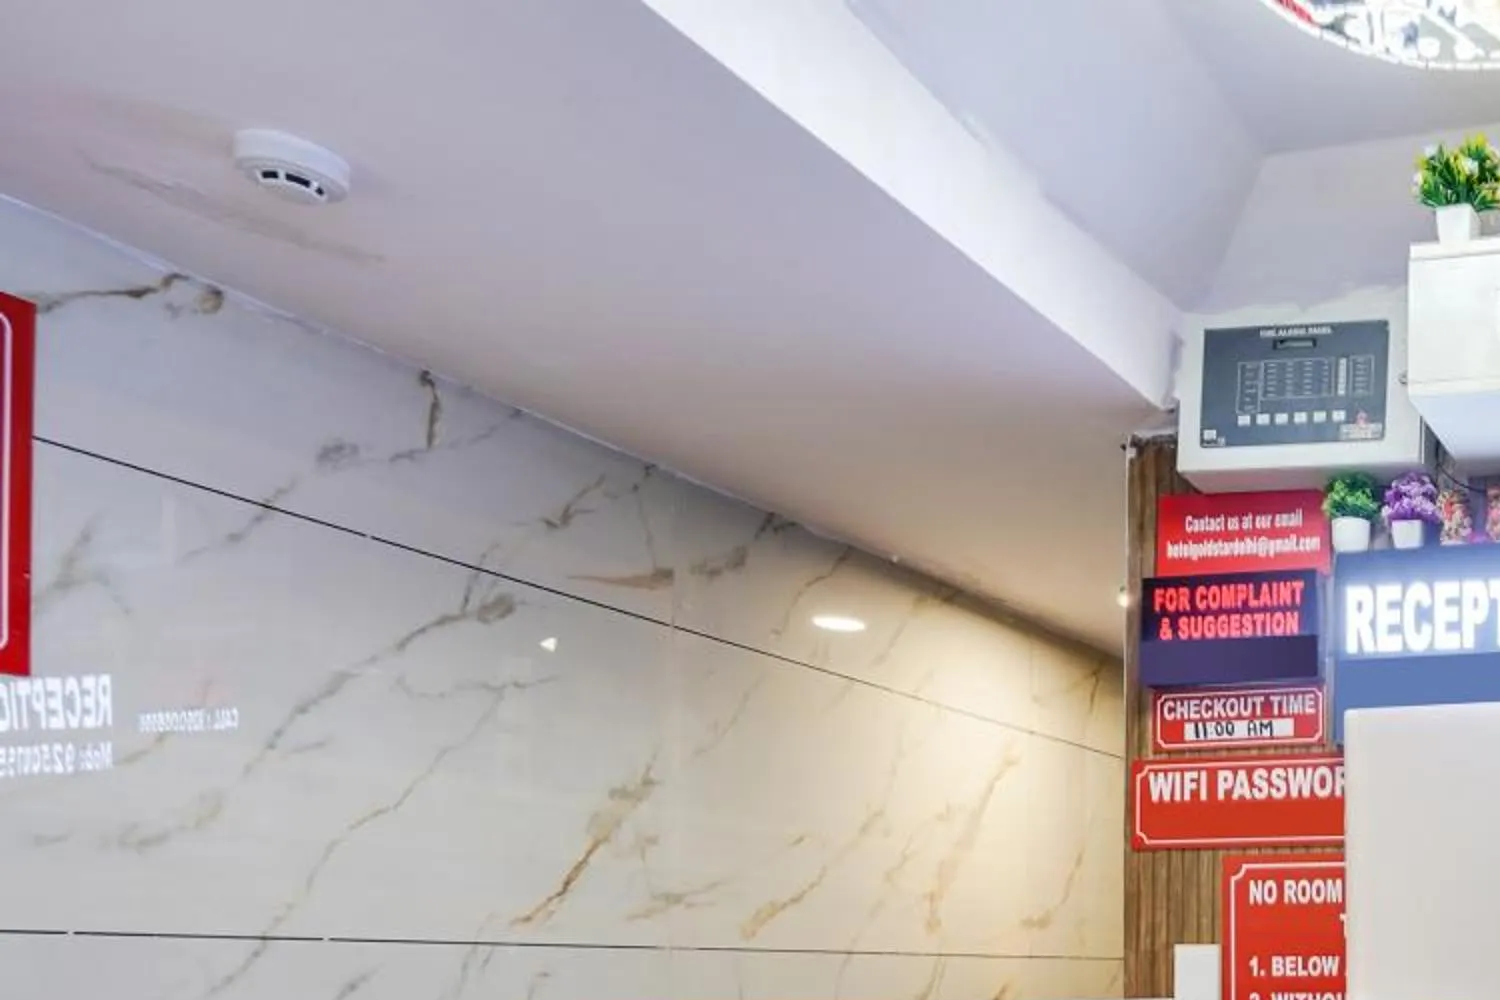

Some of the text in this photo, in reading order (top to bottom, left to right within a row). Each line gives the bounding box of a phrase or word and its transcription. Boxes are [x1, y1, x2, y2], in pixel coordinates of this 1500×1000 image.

[1185, 508, 1303, 533] Contact us at our email
[1153, 580, 1304, 613] FOR COMPLAINT
[1159, 611, 1299, 641] & SUGGESTION
[1163, 693, 1317, 721] CHECKOUT TIME
[1247, 719, 1274, 738] AM
[1149, 770, 1208, 803] WIFI
[1248, 879, 1343, 905] NO ROOM
[1249, 955, 1339, 977] 1. BELOW
